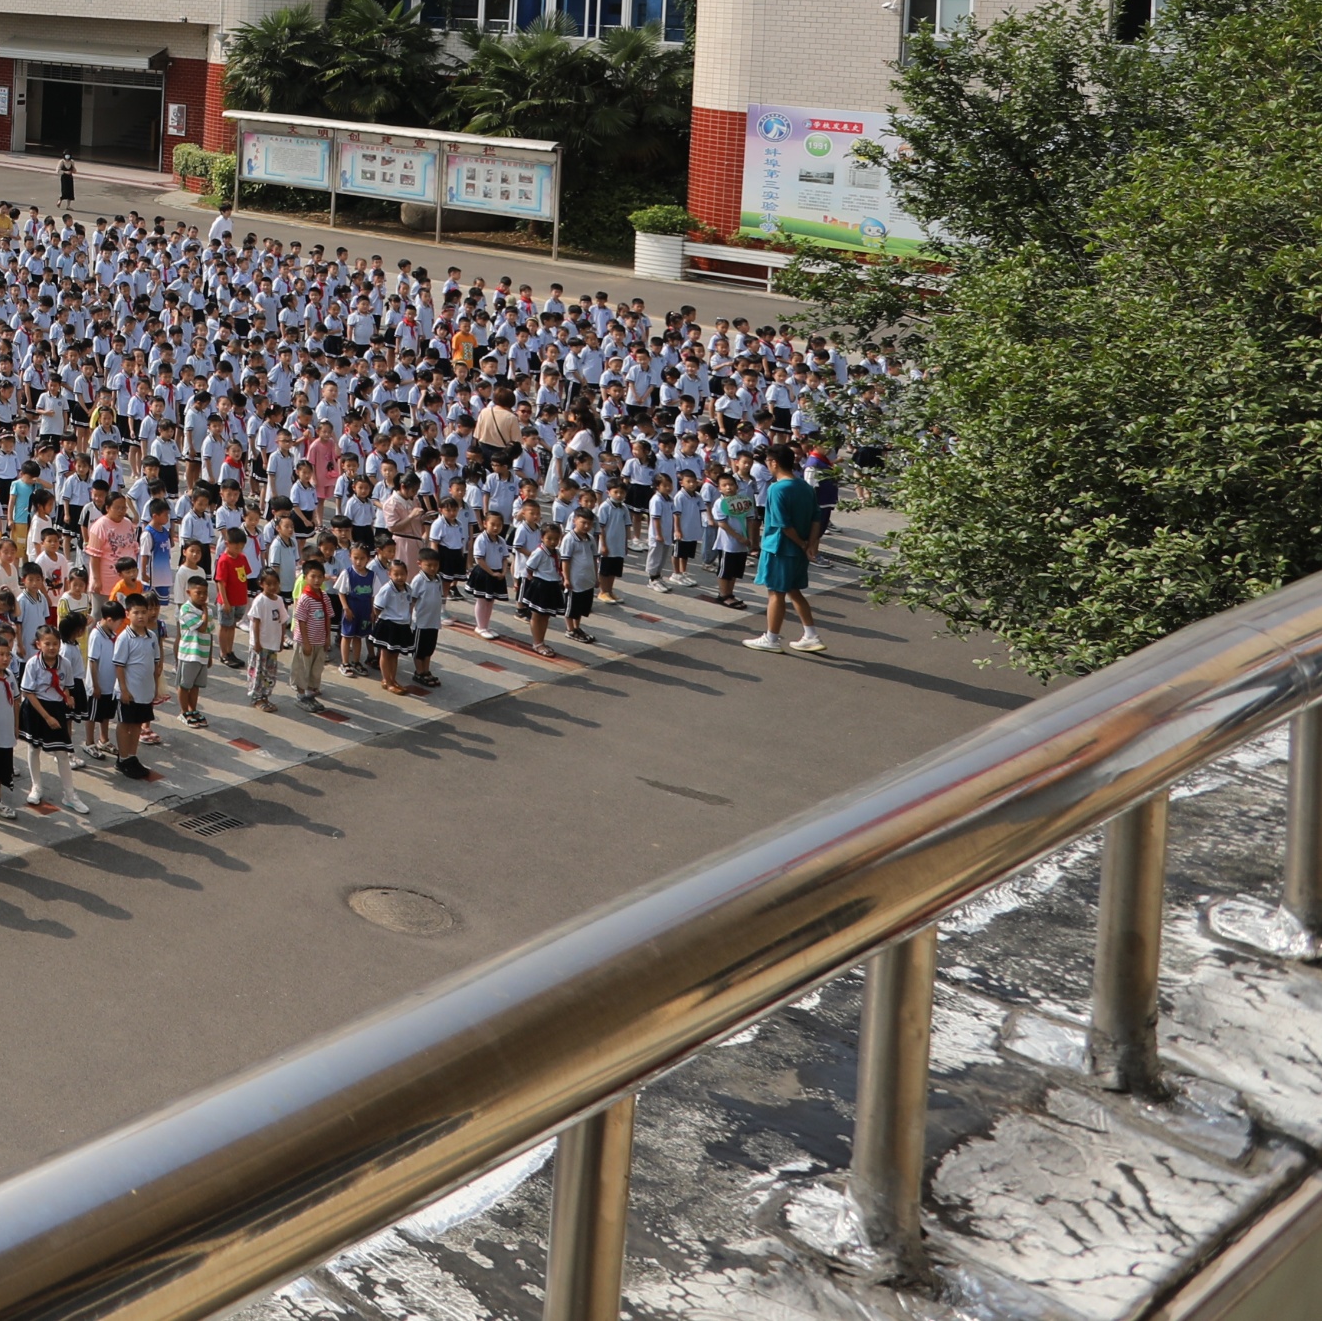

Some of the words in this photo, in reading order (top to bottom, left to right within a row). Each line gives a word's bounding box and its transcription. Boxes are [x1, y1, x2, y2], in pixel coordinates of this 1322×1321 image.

[813, 120, 861, 133] 学校发展史
[807, 141, 828, 151] 1991
[759, 147, 782, 234] 蚌埠第三实验小学
